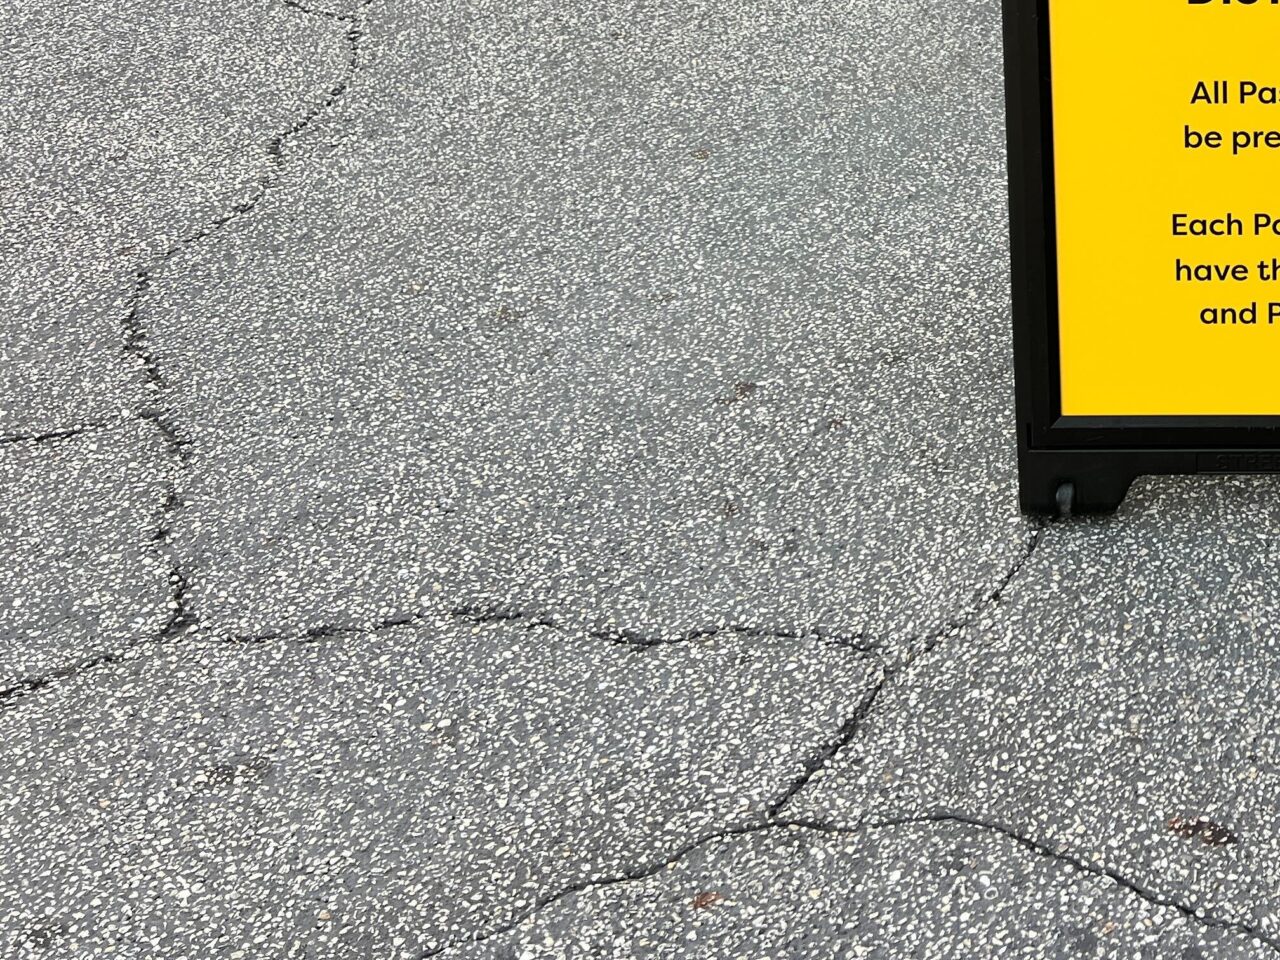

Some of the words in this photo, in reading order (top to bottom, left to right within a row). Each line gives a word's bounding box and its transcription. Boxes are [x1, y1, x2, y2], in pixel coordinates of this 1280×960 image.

[1190, 80, 1228, 105] All
[1184, 124, 1223, 149] be
[1172, 212, 1243, 236] Each
[1175, 258, 1249, 282] have
[1199, 301, 1257, 325] and
